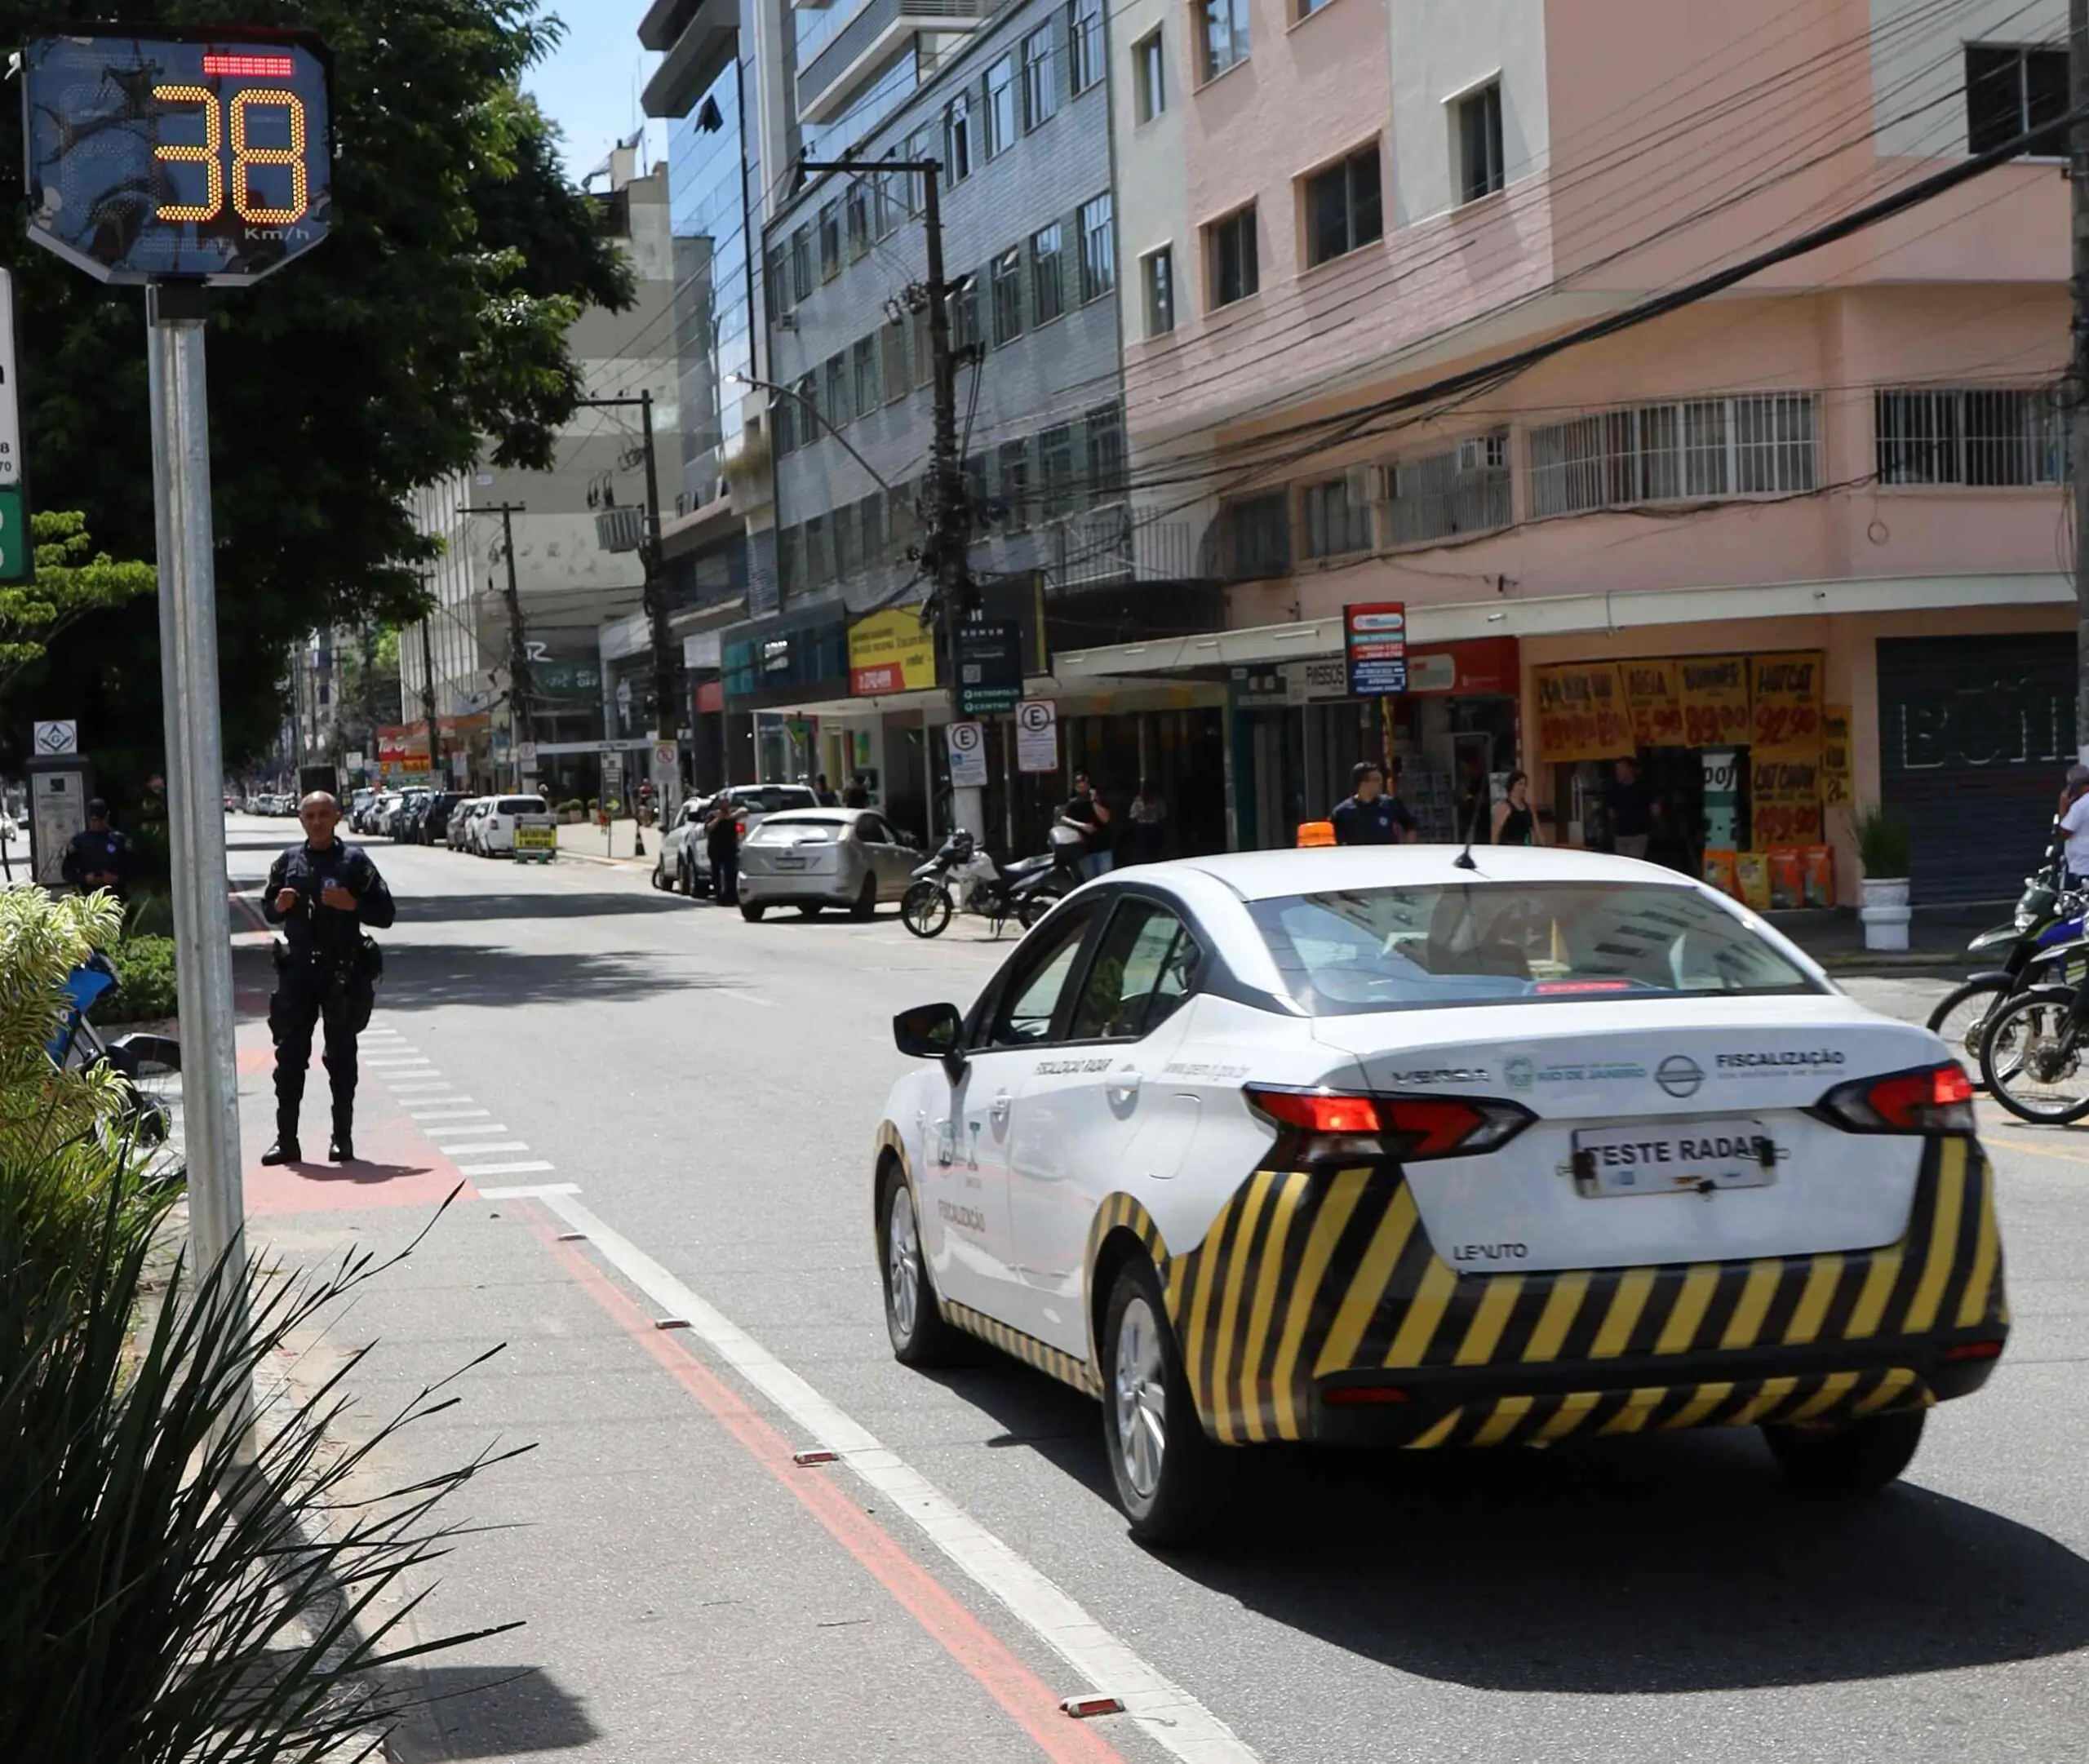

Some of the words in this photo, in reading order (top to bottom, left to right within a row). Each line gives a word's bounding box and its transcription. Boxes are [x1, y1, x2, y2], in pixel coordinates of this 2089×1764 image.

[153, 85, 308, 224] 38
[245, 228, 310, 241] Km/h
[1029, 709, 1041, 726] E
[960, 730, 970, 746] E
[1715, 1048, 1846, 1067] FISCALIZAÇÃO
[1392, 1068, 1492, 1086] VERSA
[1537, 1070, 1563, 1081] RIO
[1566, 1069, 1583, 1080] DE
